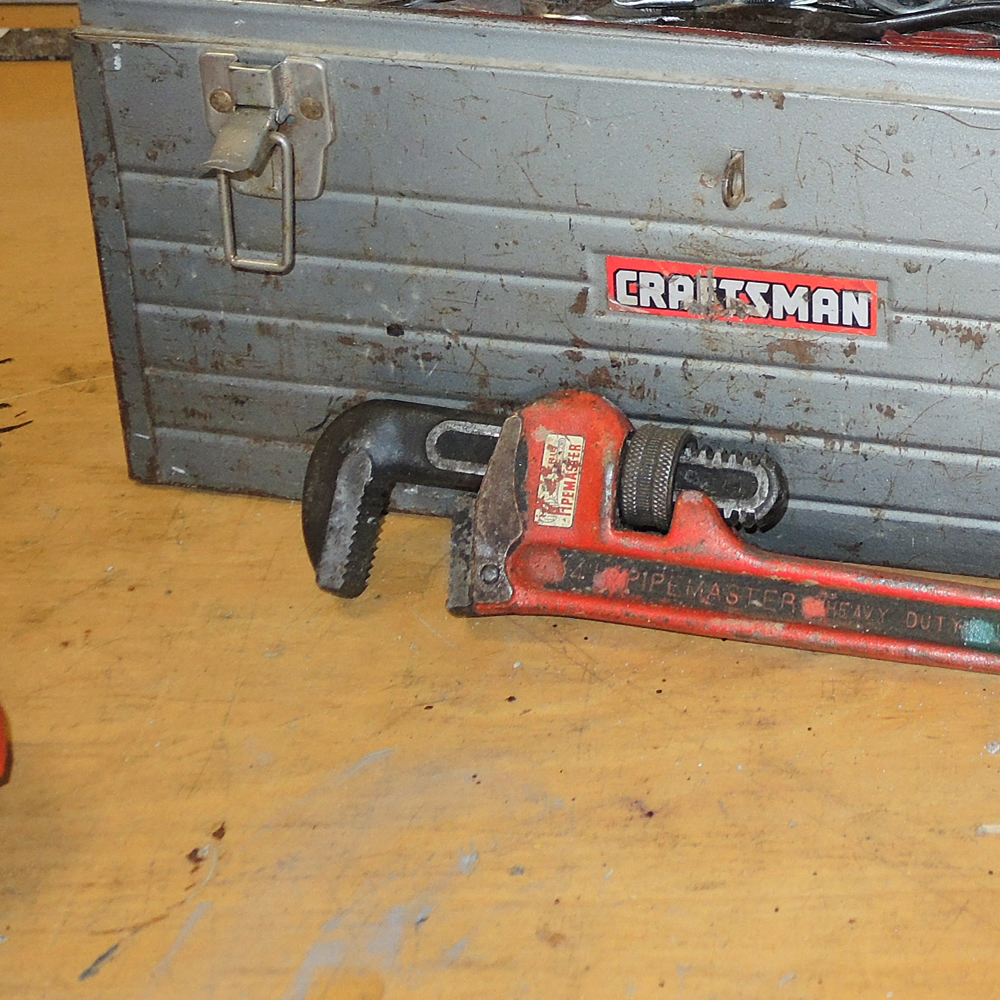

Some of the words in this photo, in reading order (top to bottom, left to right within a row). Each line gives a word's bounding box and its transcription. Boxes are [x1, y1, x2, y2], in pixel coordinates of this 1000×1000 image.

[615, 269, 870, 327] CRAFTSMAN
[626, 567, 797, 614] PIPEMASTER
[826, 600, 890, 623] HEAVY
[905, 610, 963, 633] DUTY
